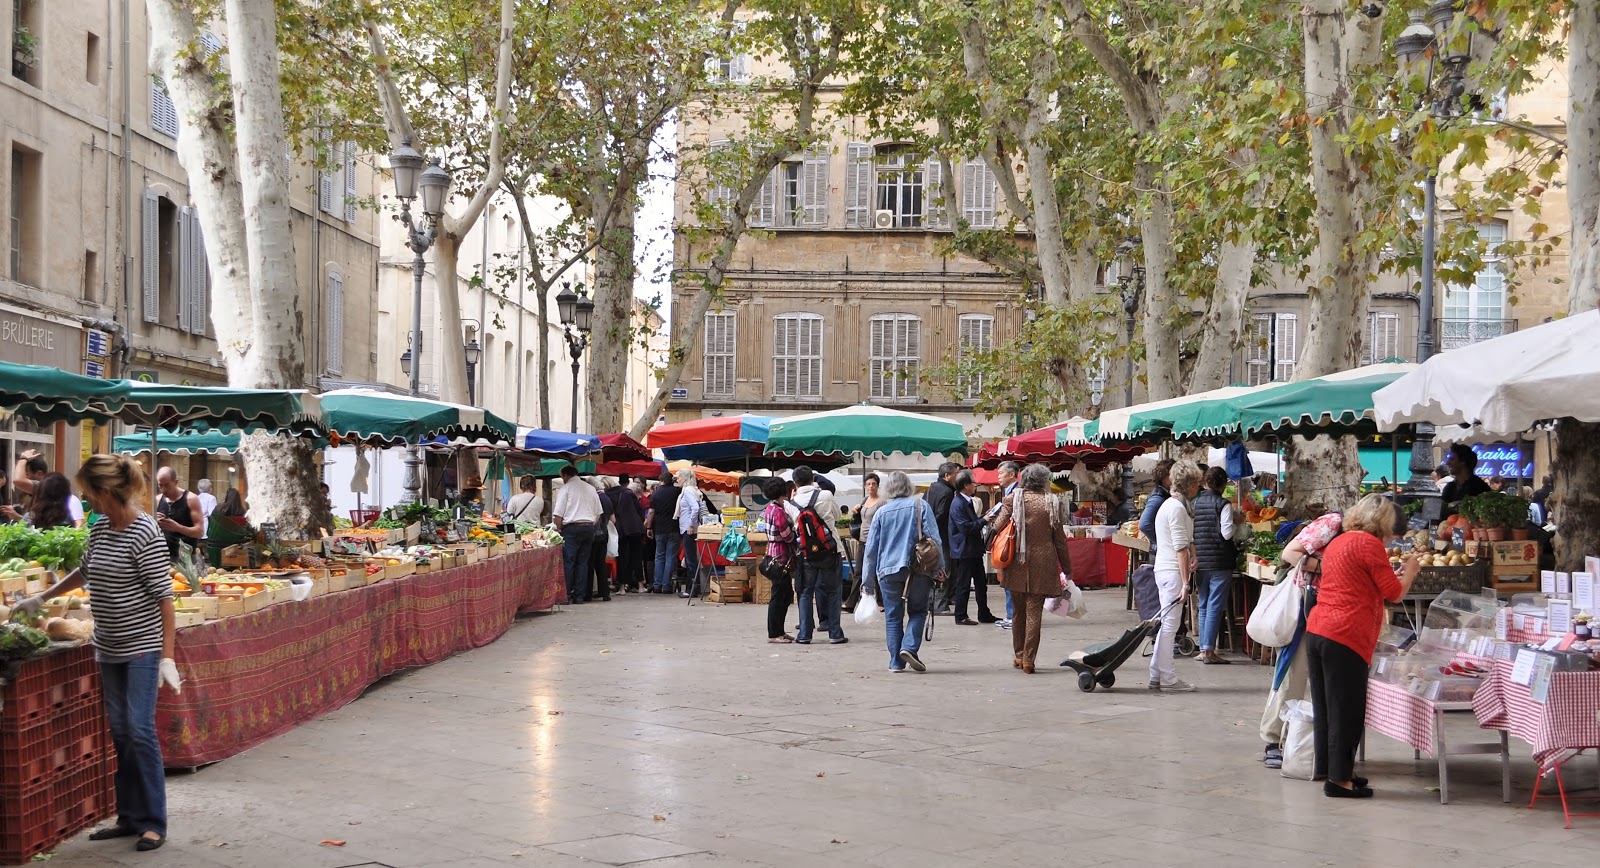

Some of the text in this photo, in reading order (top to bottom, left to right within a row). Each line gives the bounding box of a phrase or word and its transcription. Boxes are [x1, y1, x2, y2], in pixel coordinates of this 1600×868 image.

[3, 316, 54, 350] BRÛLERIE
[1475, 462, 1532, 477] du Sud
